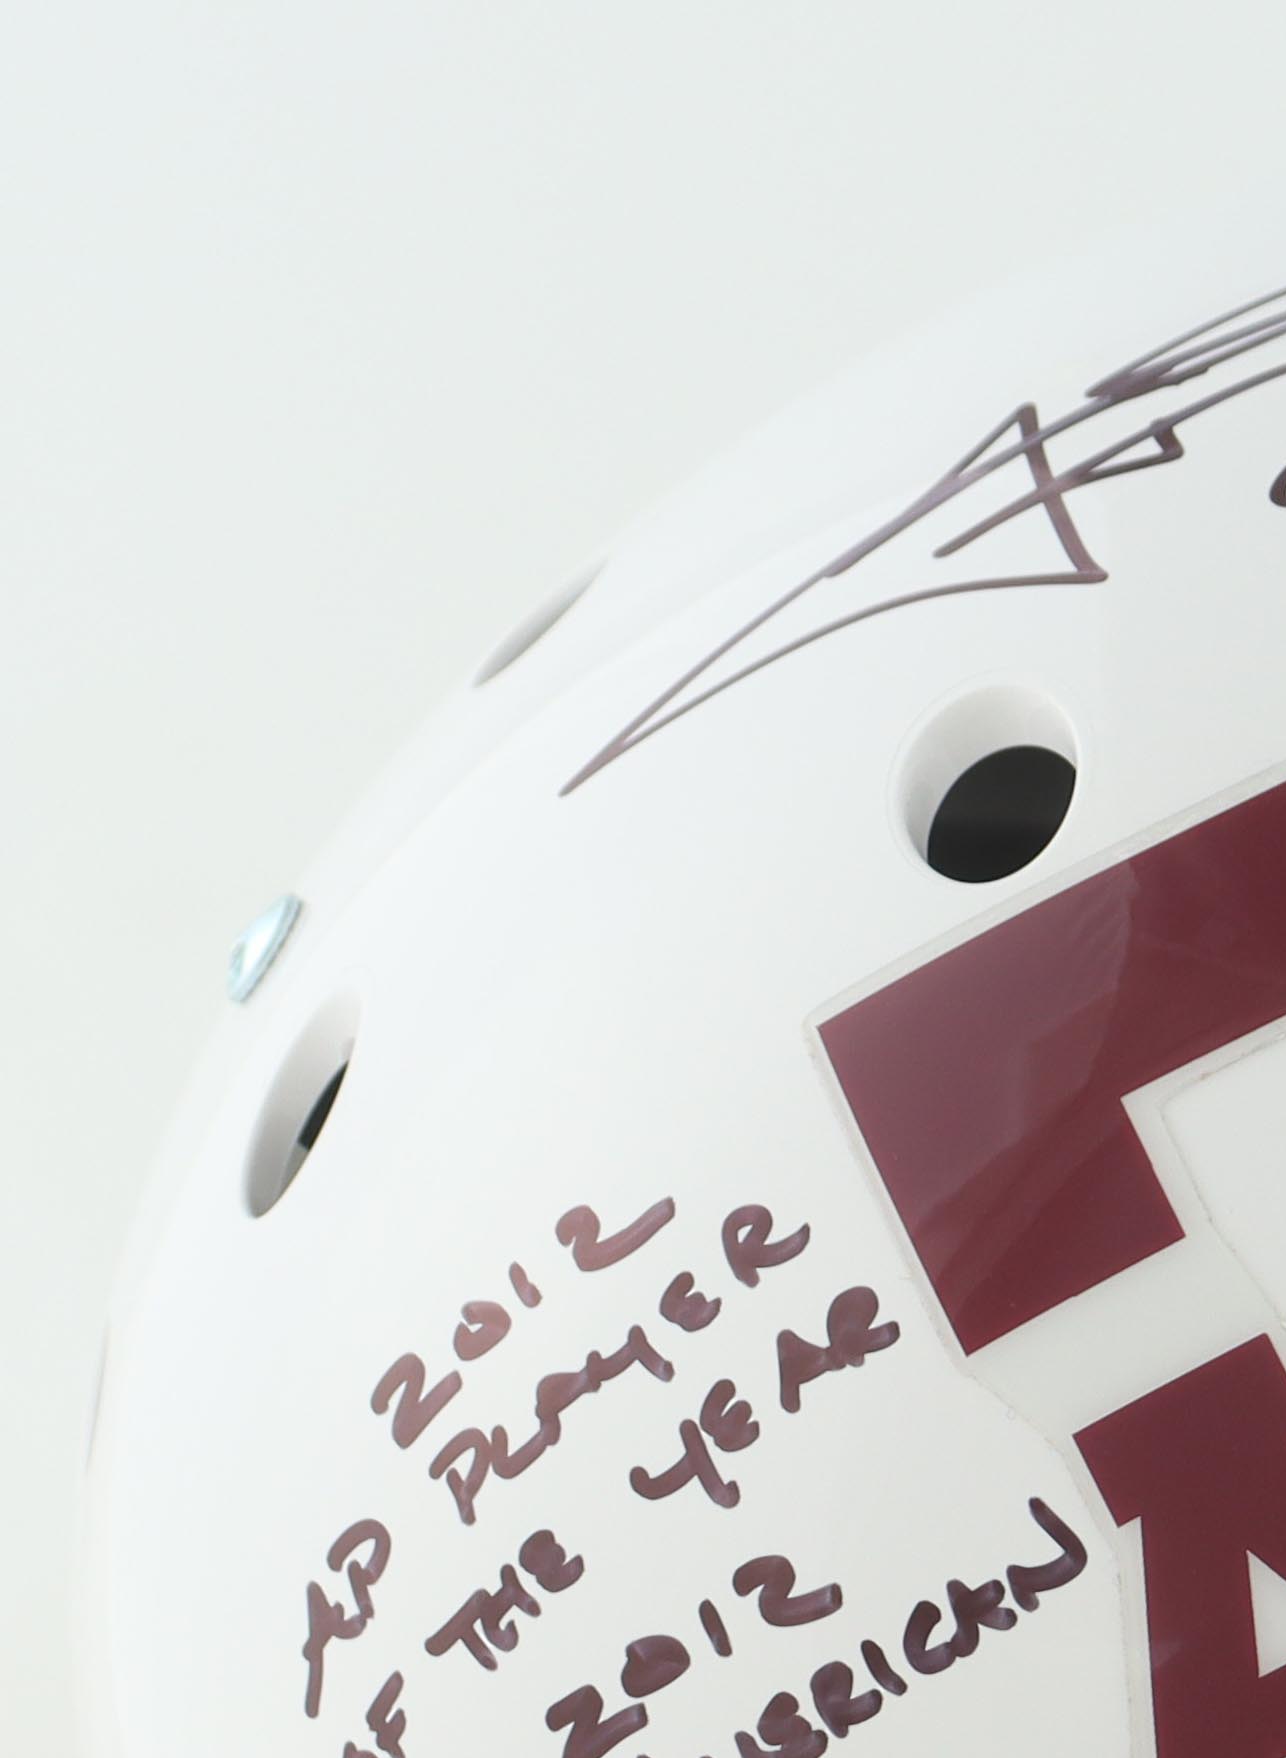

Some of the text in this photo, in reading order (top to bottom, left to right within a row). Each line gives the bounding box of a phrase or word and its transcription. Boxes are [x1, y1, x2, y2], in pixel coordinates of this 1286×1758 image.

[302, 1204, 811, 1719] AP PLAYER
[370, 1196, 676, 1450] 2012
[424, 1529, 585, 1672] THE
[628, 1285, 901, 1510] YEAR
